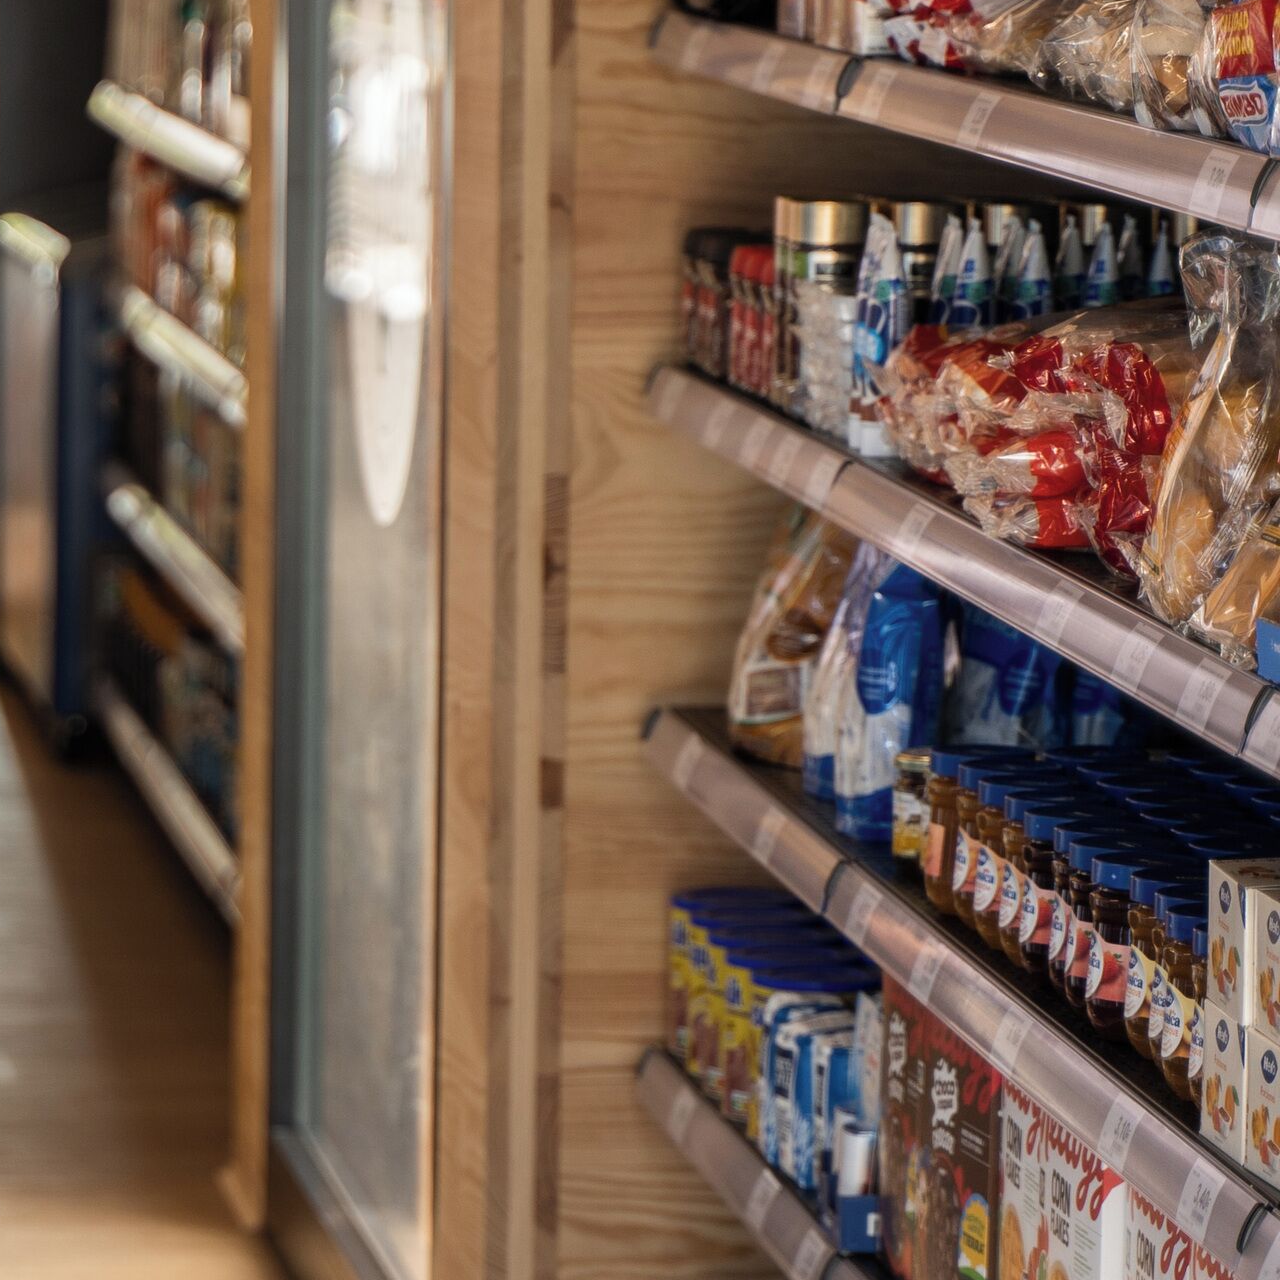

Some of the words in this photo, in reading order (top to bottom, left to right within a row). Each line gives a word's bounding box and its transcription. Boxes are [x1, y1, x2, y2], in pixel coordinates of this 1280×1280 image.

[1051, 1169, 1071, 1218] CORN
[1050, 1207, 1070, 1248] FLAKES
[1135, 1229, 1156, 1280] CORN
